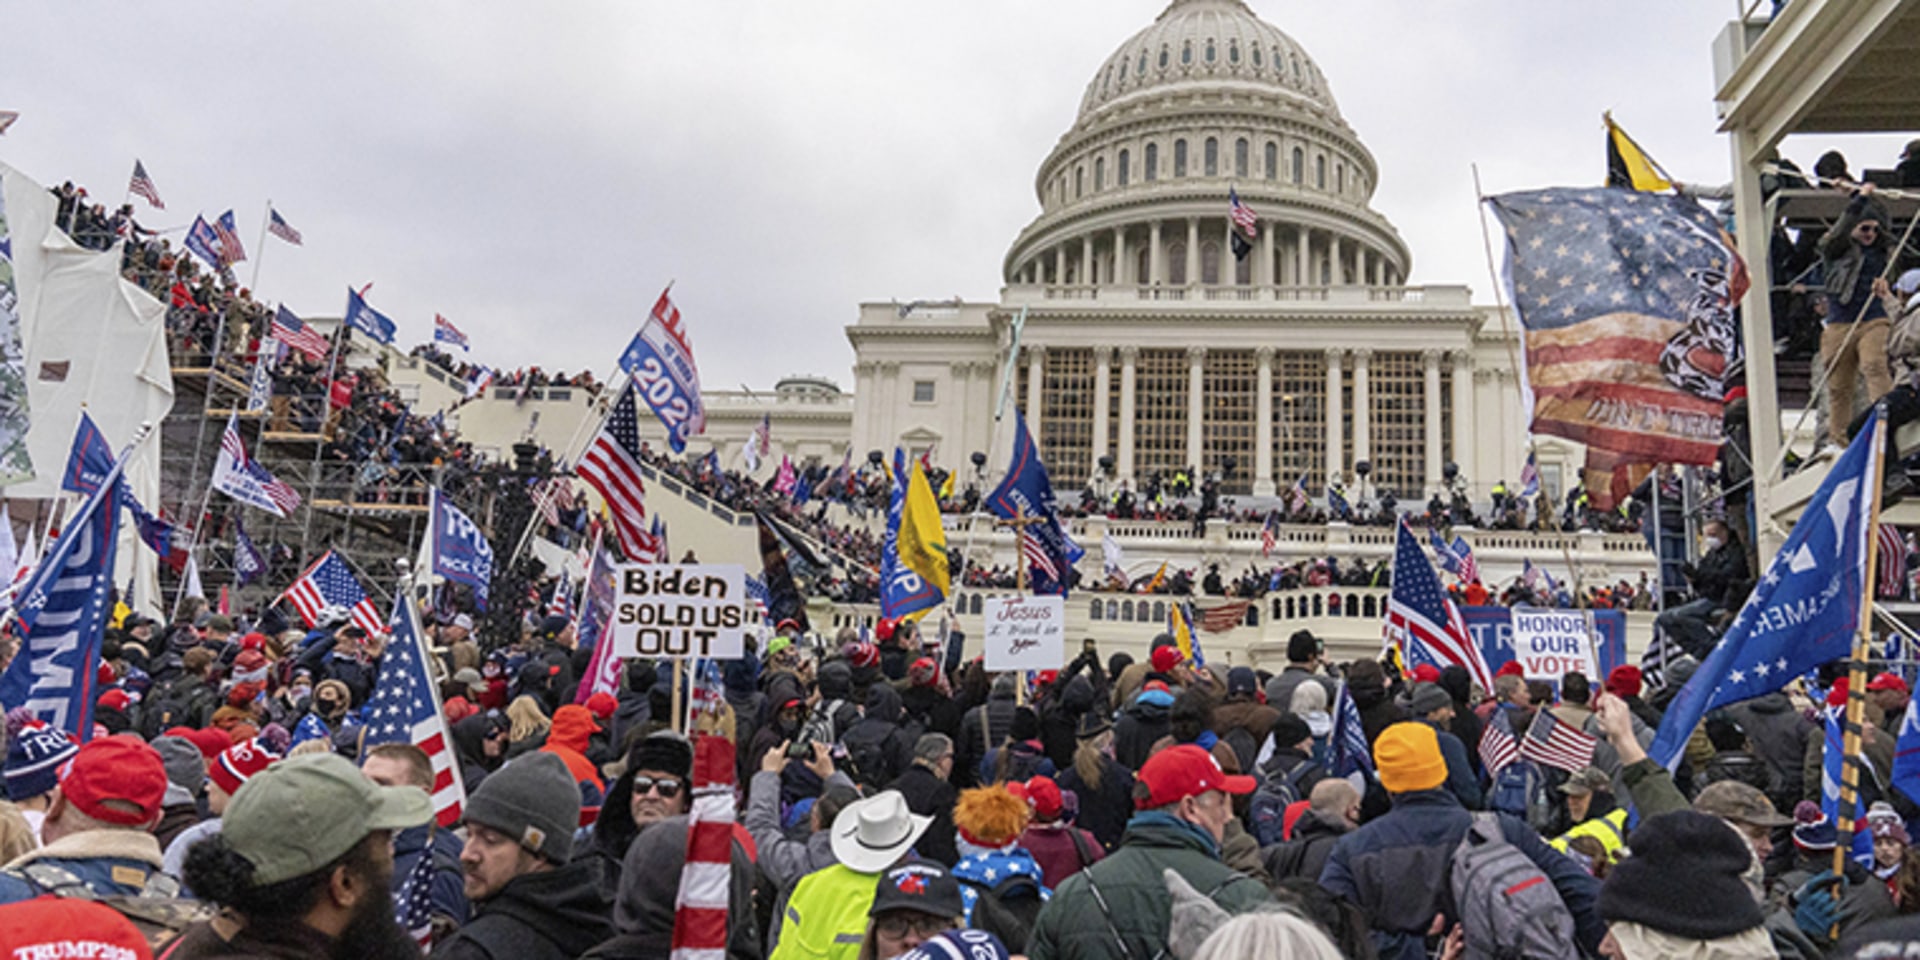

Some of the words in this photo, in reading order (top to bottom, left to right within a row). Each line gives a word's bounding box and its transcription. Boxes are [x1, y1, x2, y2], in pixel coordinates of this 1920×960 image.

[623, 568, 727, 598] Biden
[618, 603, 695, 627] SOLD
[701, 605, 741, 628] US
[996, 597, 1052, 621] Jesus
[1517, 615, 1587, 634] HONOR
[635, 628, 717, 655] OUT
[1530, 636, 1580, 654] OUR
[1525, 656, 1587, 676] VOTE
